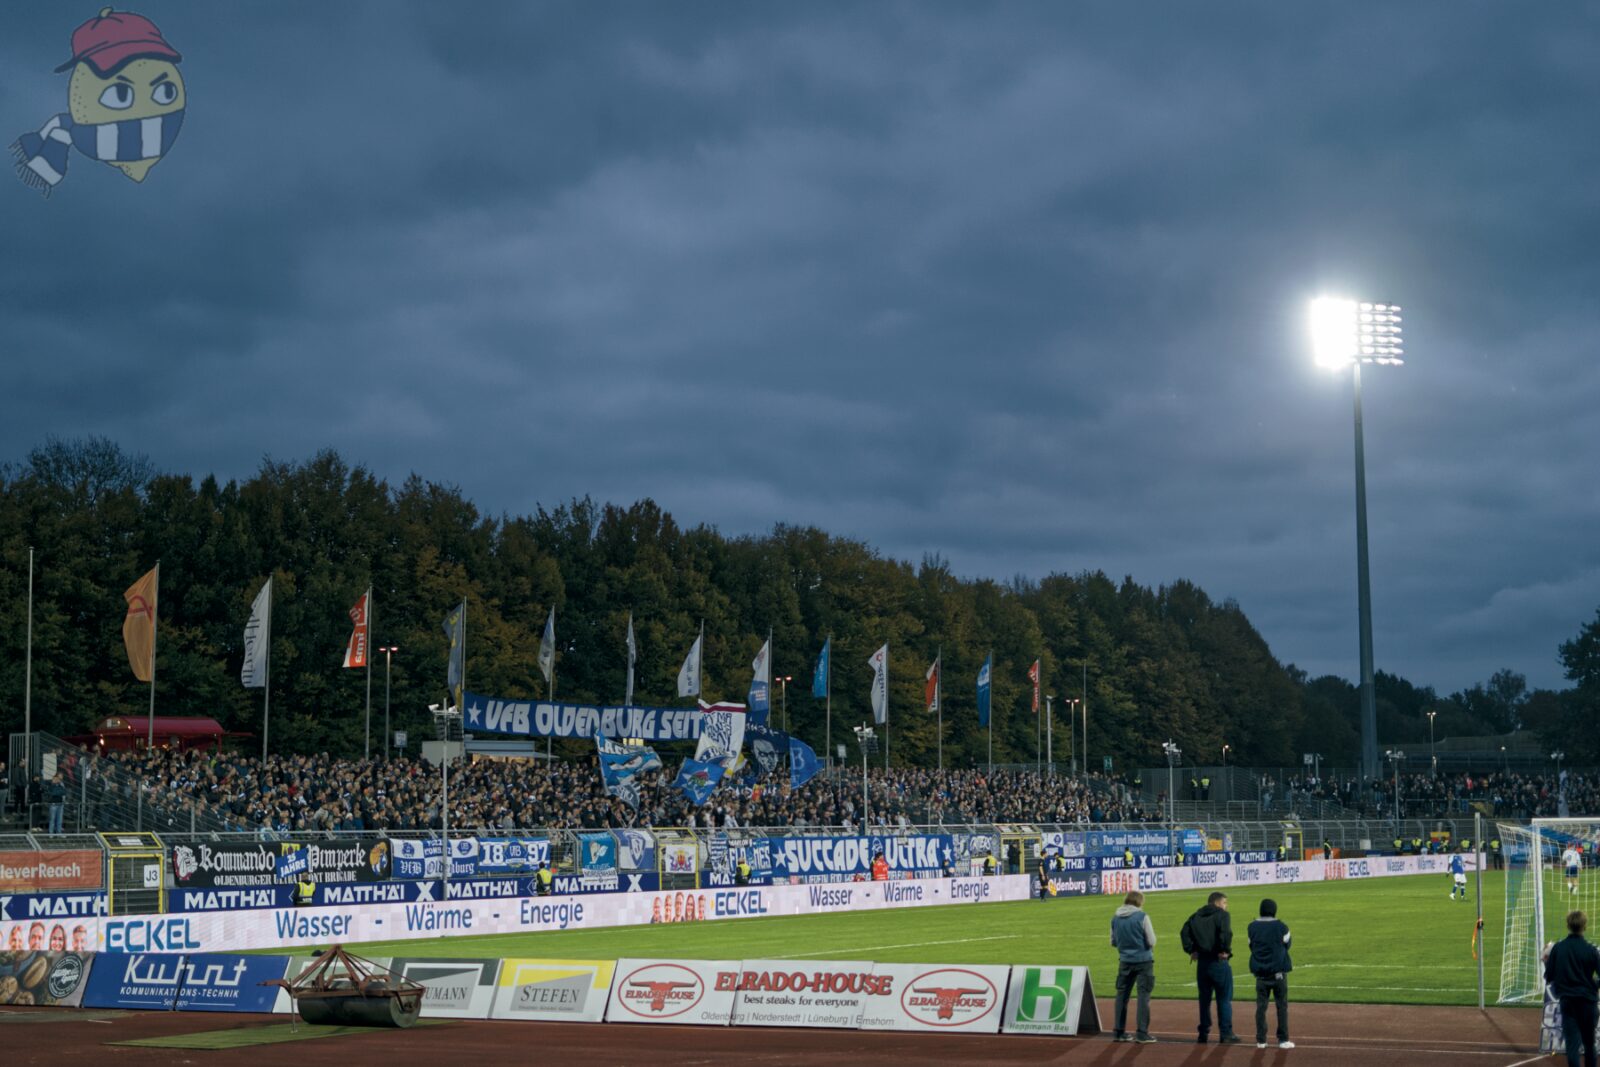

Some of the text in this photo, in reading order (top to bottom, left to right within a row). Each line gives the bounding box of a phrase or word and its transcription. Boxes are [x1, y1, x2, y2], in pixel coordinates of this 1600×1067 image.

[535, 704, 656, 739] OLDENBURG
[146, 870, 158, 881] J3
[280, 858, 306, 878] JAHRE
[426, 860, 475, 876] Oldnburg
[1192, 868, 1217, 883] Wasser
[1236, 865, 1259, 881] Wärme
[1276, 863, 1299, 881] Energie
[214, 874, 272, 886] OLDENBURGER
[325, 871, 357, 882] BRIGADE
[1138, 871, 1168, 889] ECKEL
[185, 889, 276, 910] MATTHÄI
[324, 884, 405, 903] MATTHÄI
[447, 880, 517, 898] MATTHÄI
[810, 885, 853, 907] Wasser
[884, 882, 922, 902] Wärme
[951, 878, 989, 901] Energie
[715, 890, 767, 916] ECKEL
[276, 910, 352, 938] Wasser
[406, 903, 472, 931] Wärme
[521, 898, 583, 929] Energie
[106, 919, 200, 952] ECKEL
[424, 986, 468, 1000] UMANN
[714, 971, 893, 995] ELRADO-HOUSE
[520, 985, 580, 1003] STEFEN
[744, 994, 859, 1008] best steaks for everyone
[701, 1011, 745, 1022] Oldenburg
[752, 1012, 801, 1023] Norderstedt
[808, 1013, 848, 1025] Lüneburg
